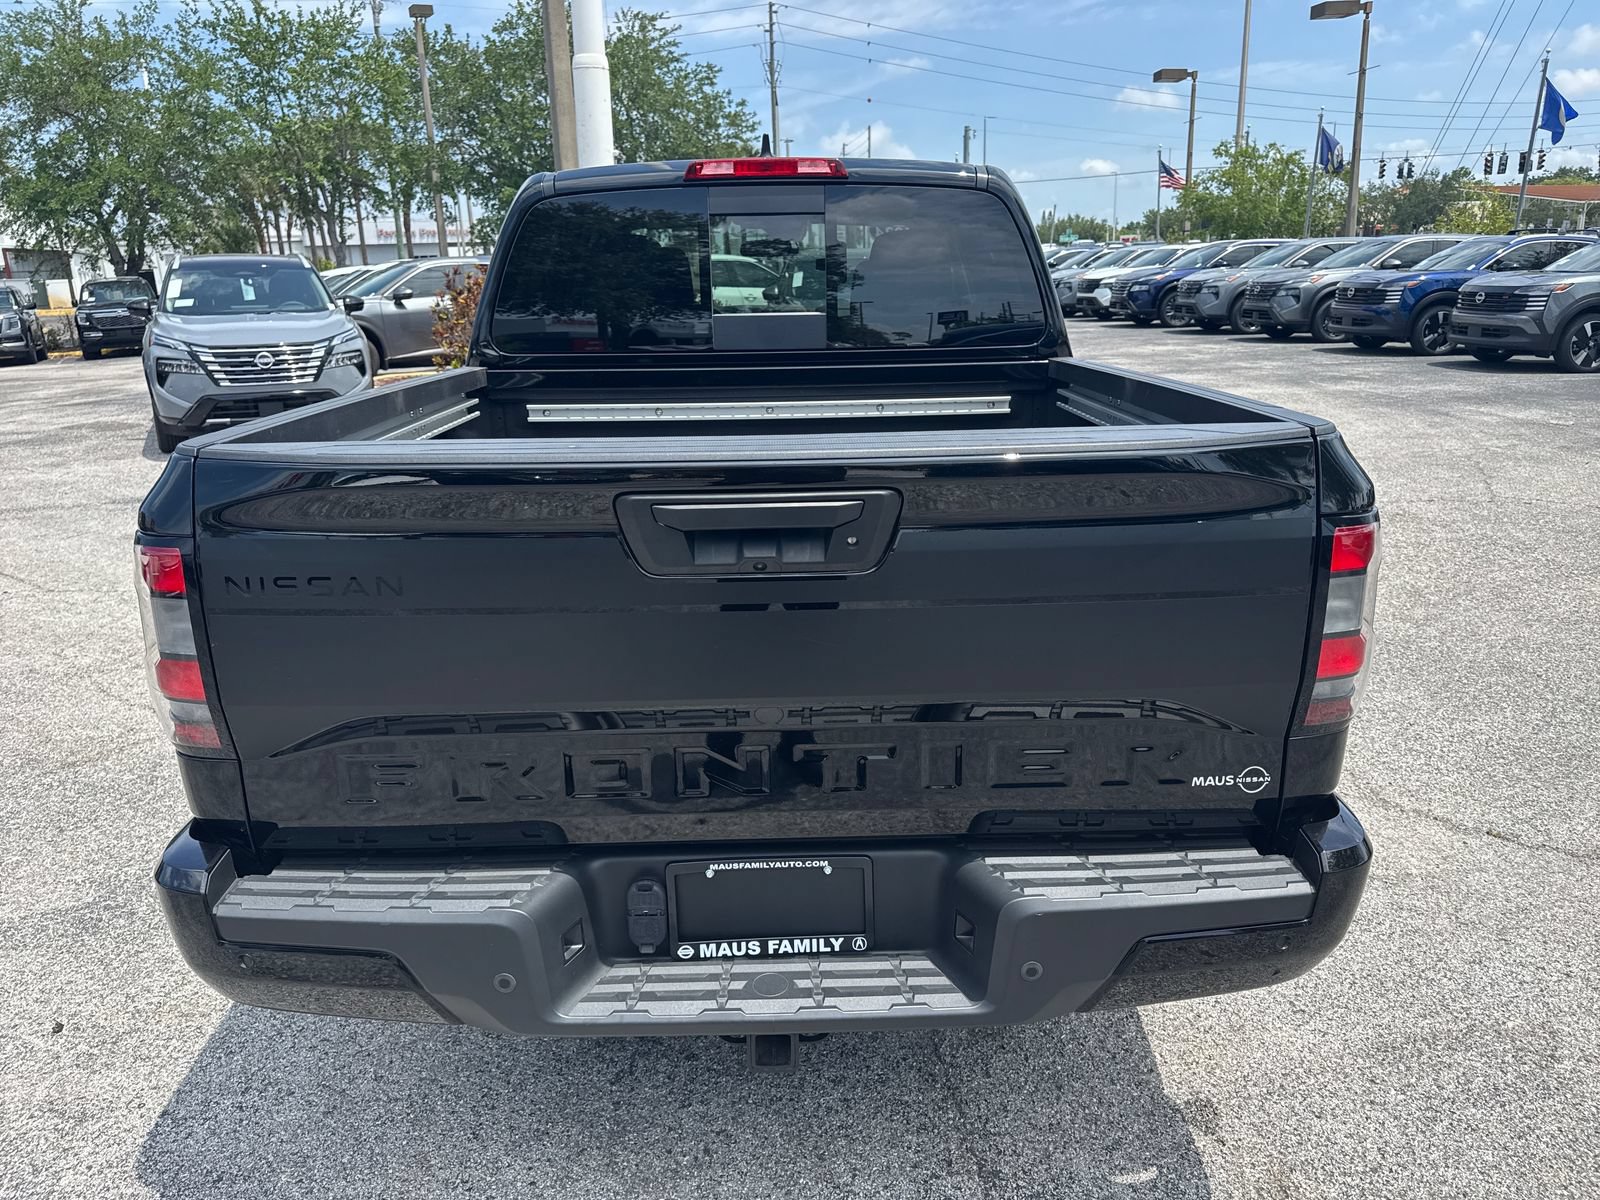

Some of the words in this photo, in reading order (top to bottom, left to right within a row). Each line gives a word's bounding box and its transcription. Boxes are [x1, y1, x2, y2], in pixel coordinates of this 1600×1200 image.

[224, 576, 404, 597] NISSAN
[336, 743, 1186, 804] FRONTIER
[1191, 775, 1235, 787] MAUS
[1235, 776, 1271, 784] NISSAN
[709, 860, 829, 871] MAUSFAMILYAUTO.COM
[700, 941, 761, 959] MAUS
[768, 937, 845, 954] FAMILY
